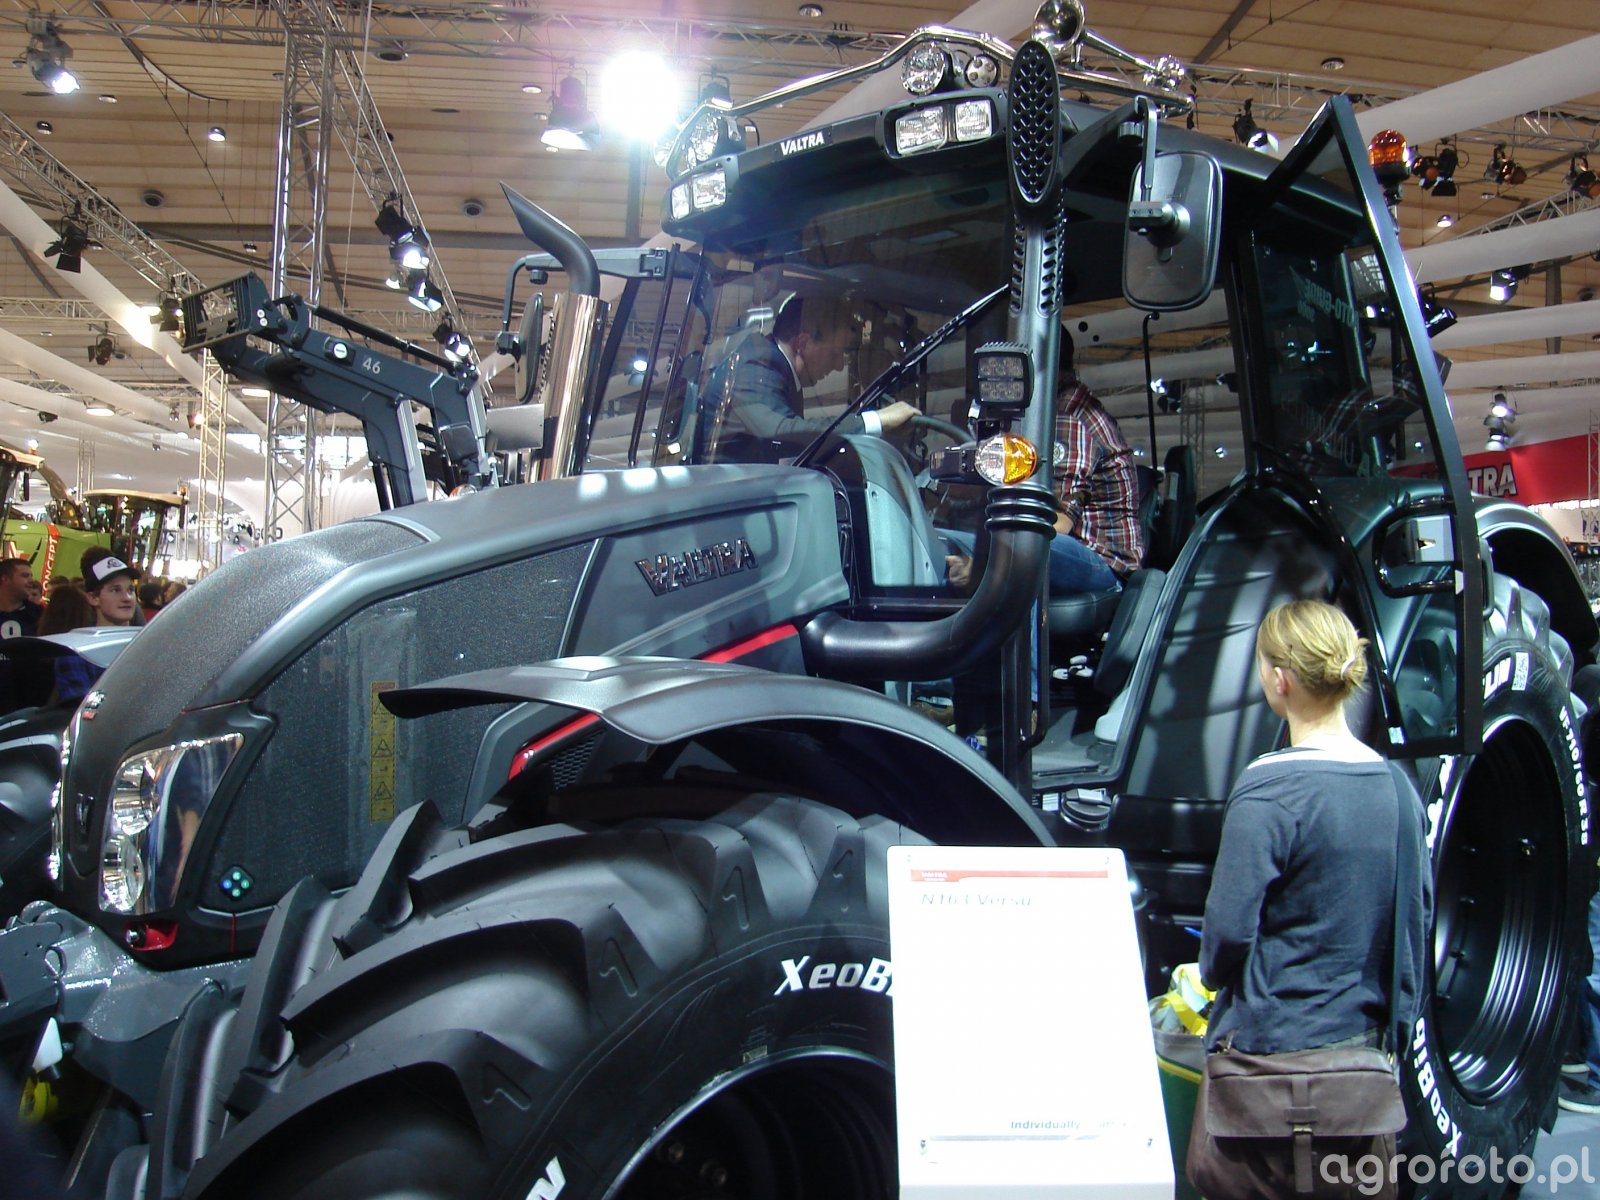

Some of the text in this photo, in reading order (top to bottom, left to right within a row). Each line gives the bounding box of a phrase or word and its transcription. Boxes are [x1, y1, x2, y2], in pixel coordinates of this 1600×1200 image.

[780, 131, 825, 156] VALTRA
[362, 357, 381, 374] 46
[1467, 463, 1518, 497] TRA
[635, 538, 759, 597] VALTRA
[773, 956, 893, 997] XeoB
